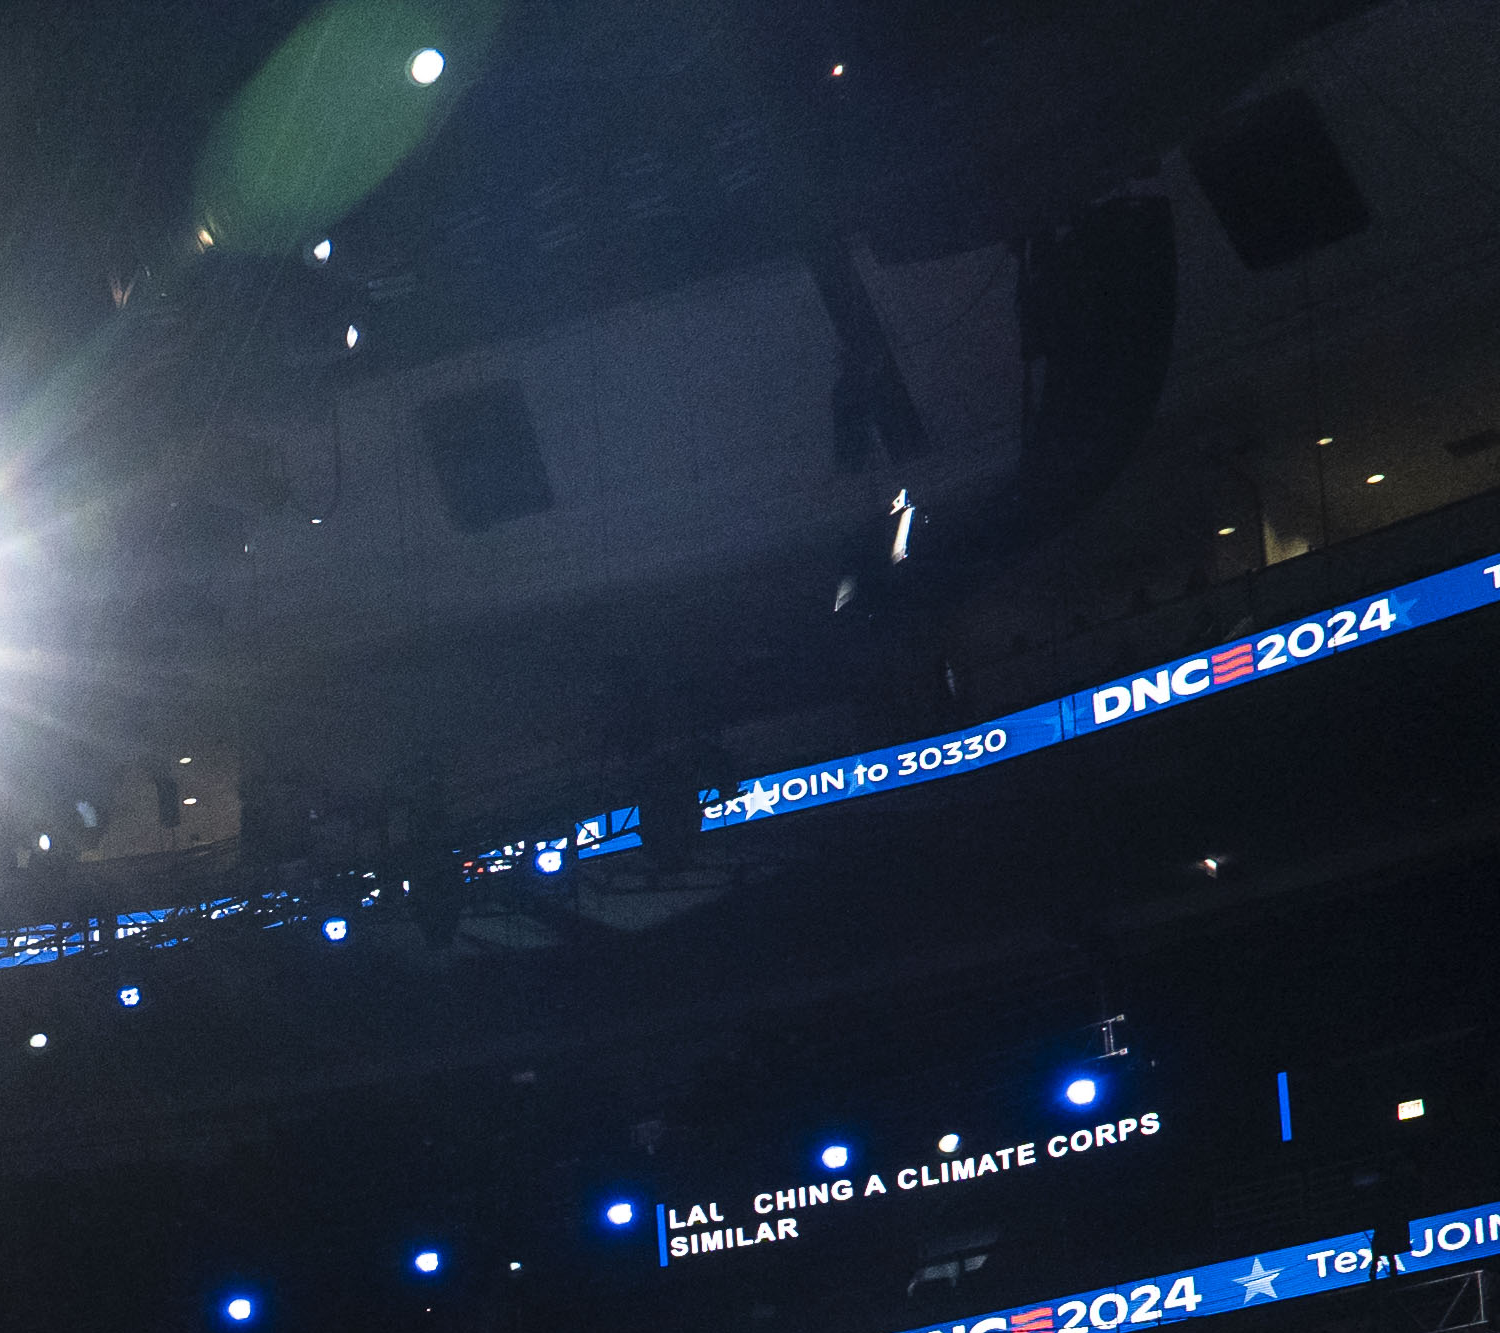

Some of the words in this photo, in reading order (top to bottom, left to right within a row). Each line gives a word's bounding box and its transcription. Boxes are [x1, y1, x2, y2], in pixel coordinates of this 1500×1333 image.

[1092, 658, 1210, 724] DNC
[1257, 598, 1397, 671] 2024
[762, 768, 845, 806] JOIN
[853, 763, 889, 785] to
[897, 728, 1007, 776] 30330
[864, 1174, 887, 1197] A
[896, 1143, 1038, 1191] CLIMATE
[1047, 1112, 1160, 1158] CORPS
[668, 1216, 800, 1258] SIMILAR
